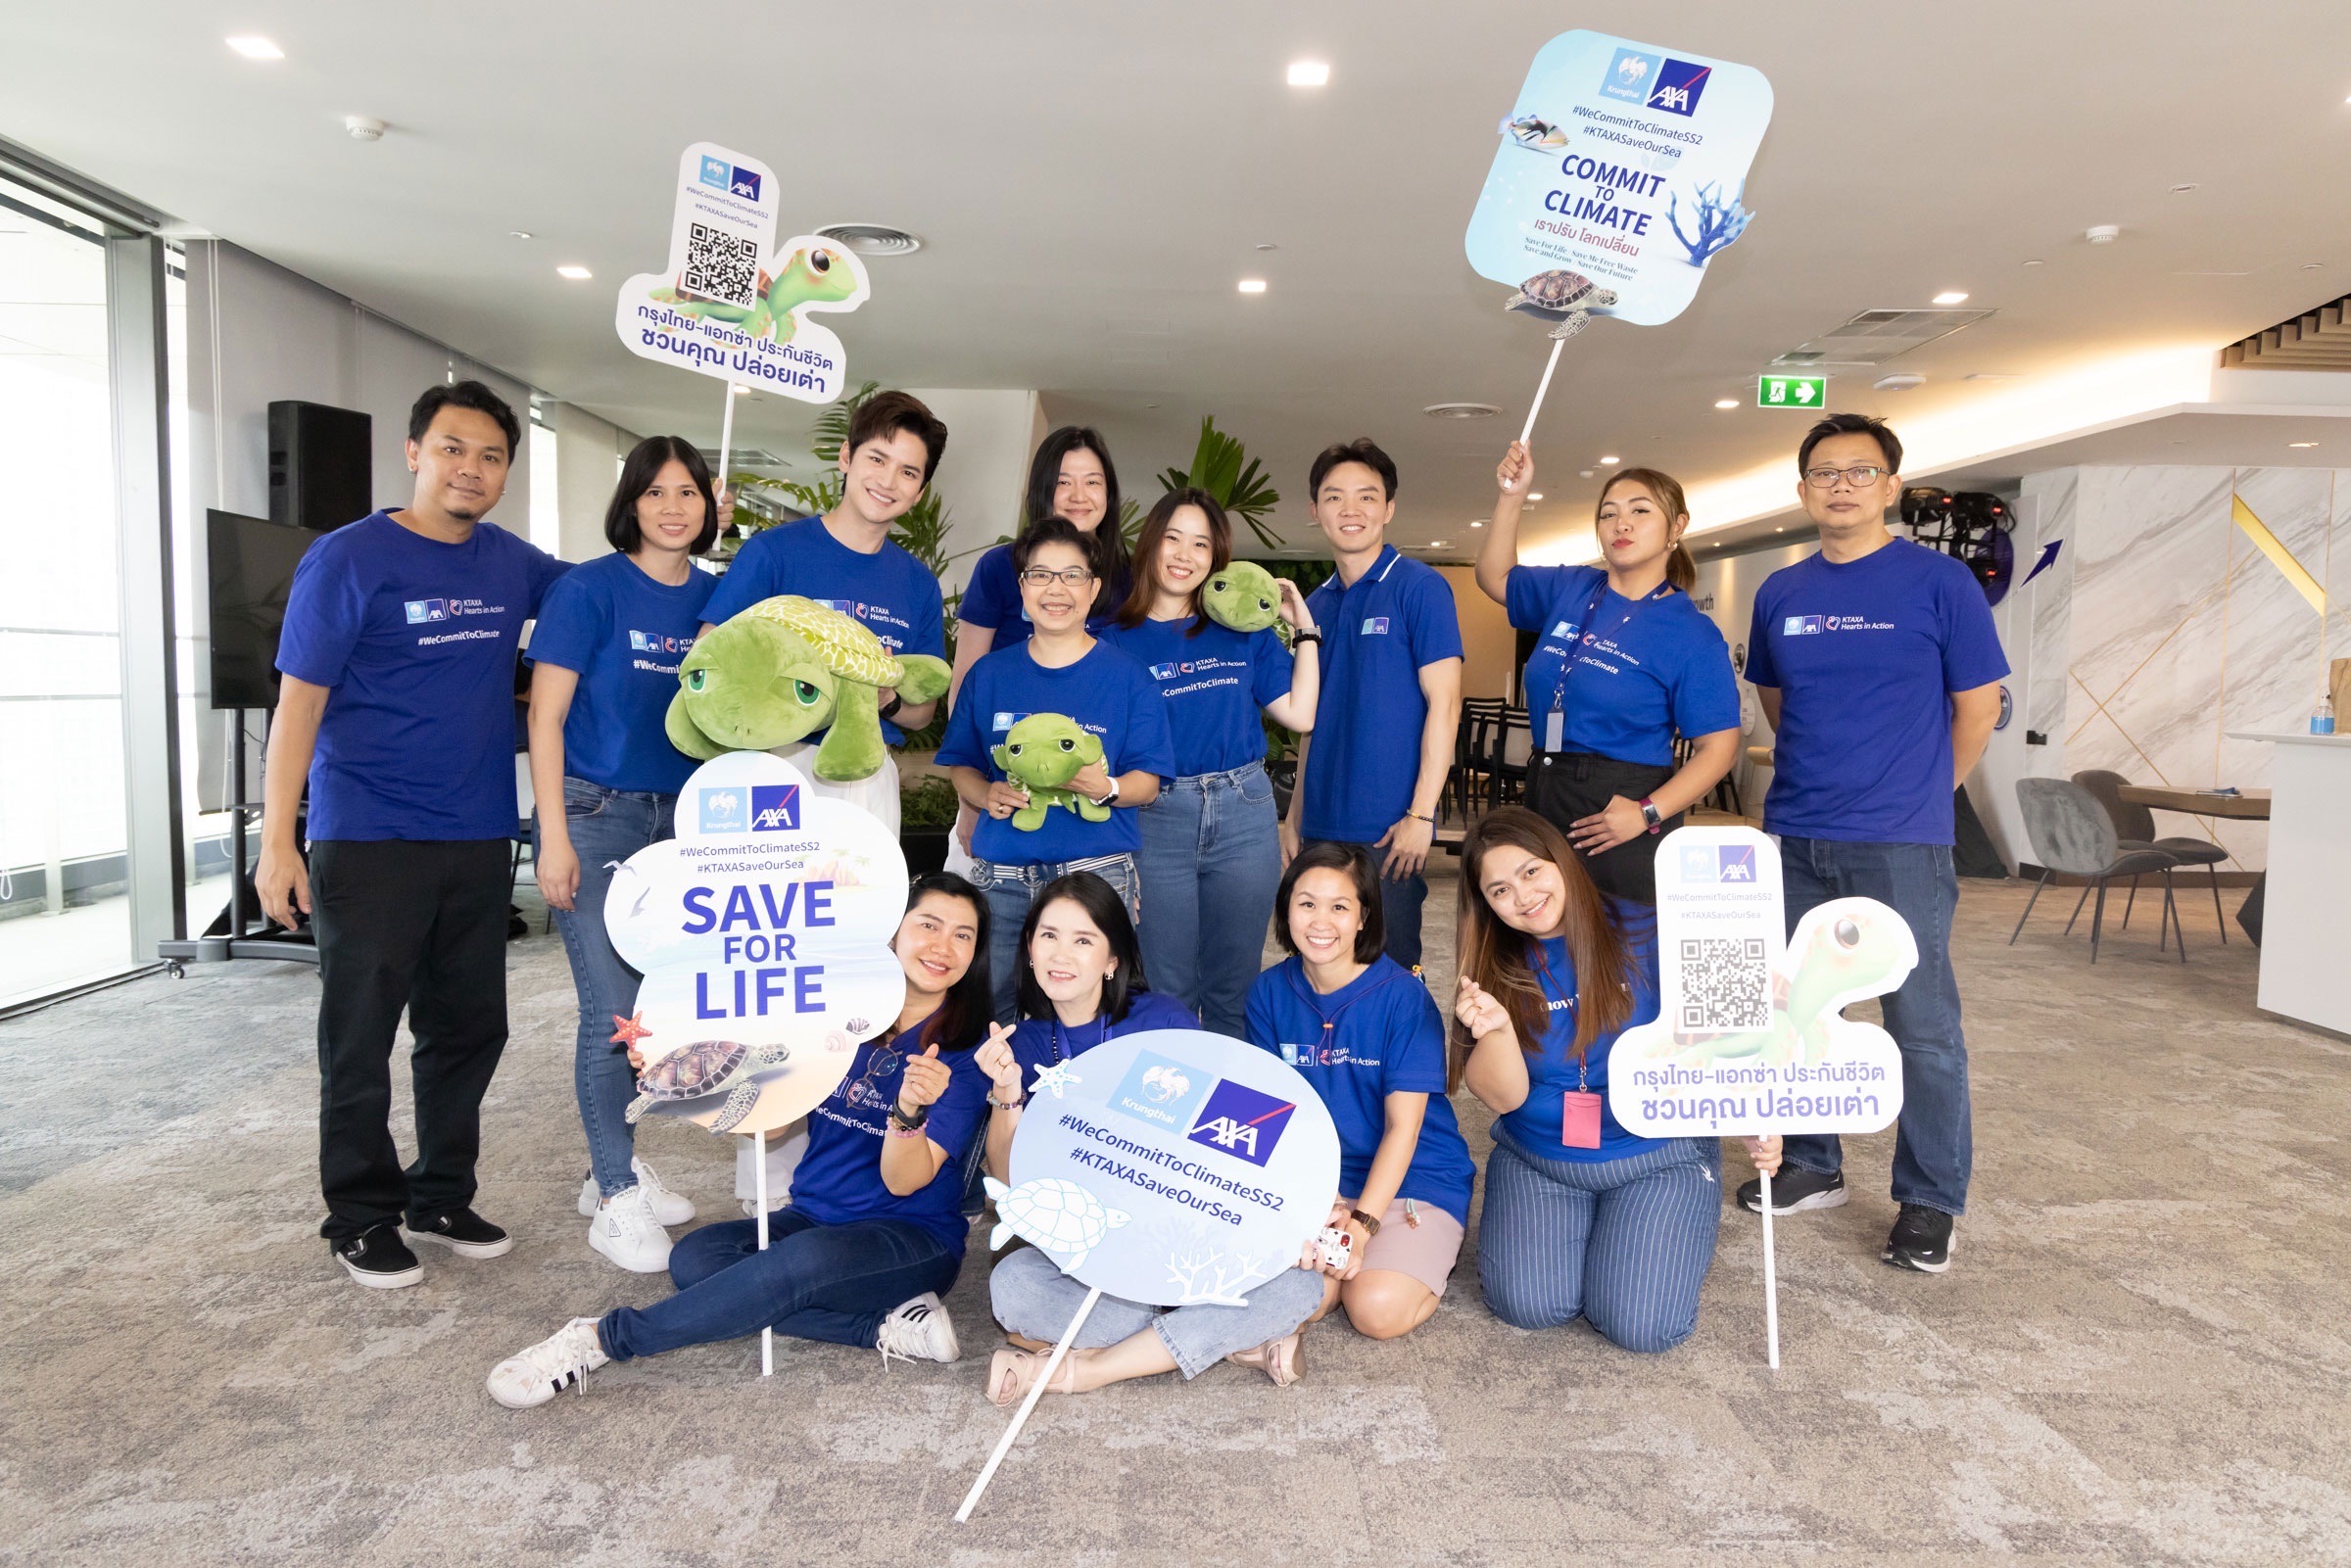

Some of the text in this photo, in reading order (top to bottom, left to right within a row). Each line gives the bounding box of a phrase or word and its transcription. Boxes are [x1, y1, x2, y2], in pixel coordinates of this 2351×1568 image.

[1648, 85, 1689, 112] AXA
[1572, 105, 1703, 146] #WeCommitToClimateSS2
[1583, 125, 1682, 158] #KTAXASaveOurSea
[1560, 154, 1666, 198] COMMIT
[731, 181, 755, 199] AXA
[1595, 185, 1614, 202] TO
[686, 185, 769, 219] #WeCommitToClimateSS2
[695, 202, 758, 228] #KTAXASaveOurSea
[1544, 189, 1653, 236] CLIMATE
[1534, 217, 1640, 258] เราปรับ โลกเปลี่ยน
[1524, 244, 1634, 282] Save and Grow Save Our Future
[1525, 236, 1639, 274] Save For Life Save Me Free Waste
[642, 328, 826, 393] ชวนคุณ ปล่อยเต่า
[757, 338, 834, 371] ประกันชีวิต
[463, 606, 483, 615] Hearts
[870, 605, 889, 616] KTAXA
[870, 613, 889, 623] Hearts
[895, 617, 910, 629] Action
[1802, 624, 1817, 633] AXA
[1841, 622, 1863, 631] Hearts
[1871, 621, 1895, 630] Action
[417, 630, 501, 646] #WeCommitToClimate
[679, 638, 696, 646] KTA
[1602, 639, 1618, 649] TAXA
[1196, 657, 1218, 666] KTAXA
[1197, 662, 1220, 672] Hearts
[1620, 651, 1640, 667] Action
[1159, 669, 1173, 678] AXA
[1162, 677, 1239, 698] CommitToClimate
[1083, 723, 1107, 735] Action
[752, 808, 792, 829] AXA
[680, 841, 821, 858] #WeCommitToClimateSS2
[696, 860, 804, 874] #KTAXASaveOurSea
[1720, 864, 1751, 880] AXA
[681, 879, 836, 934] SAVE
[1667, 892, 1772, 902] #WeCommitToClimateSS2
[1681, 911, 1761, 921] #KTAXASaveOurSea
[724, 933, 796, 965] FOR
[696, 965, 827, 1020] LIFE
[1296, 1055, 1310, 1065] AXA
[1357, 1057, 1380, 1067] Action
[1783, 1061, 1886, 1083] ประกันชีวิต
[879, 1102, 888, 1112] in
[1121, 1096, 1176, 1124] Krungthai
[1641, 1087, 1880, 1129] ชวนคุณ ปล่อยเต่า
[1190, 1116, 1259, 1158] AXA
[1058, 1113, 1285, 1212] #WeCommitToClimateSS2
[1069, 1146, 1243, 1226] #KTAXASaveOurSea
